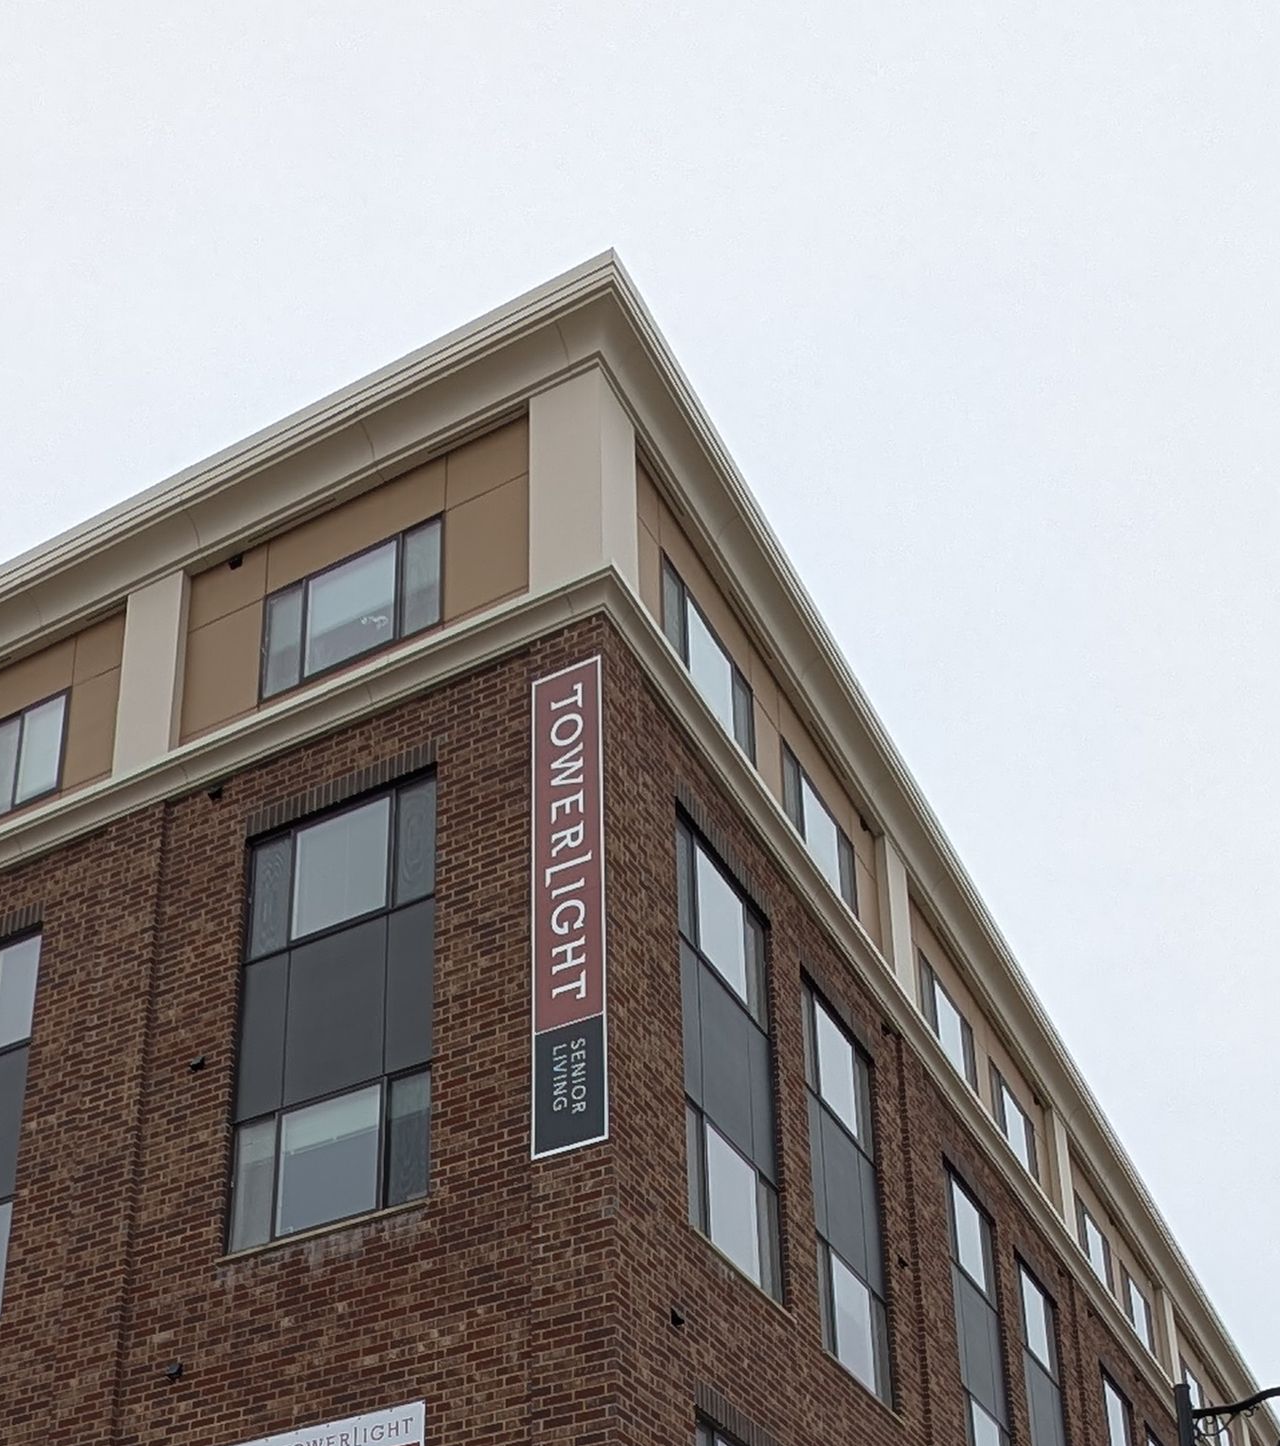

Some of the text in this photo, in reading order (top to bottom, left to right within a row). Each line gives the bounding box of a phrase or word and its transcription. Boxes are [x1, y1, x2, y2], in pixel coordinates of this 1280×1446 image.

[545, 682, 593, 1001] TOWERLIGHT
[552, 1043, 568, 1112] LIVING
[570, 1037, 587, 1115] SENIOR
